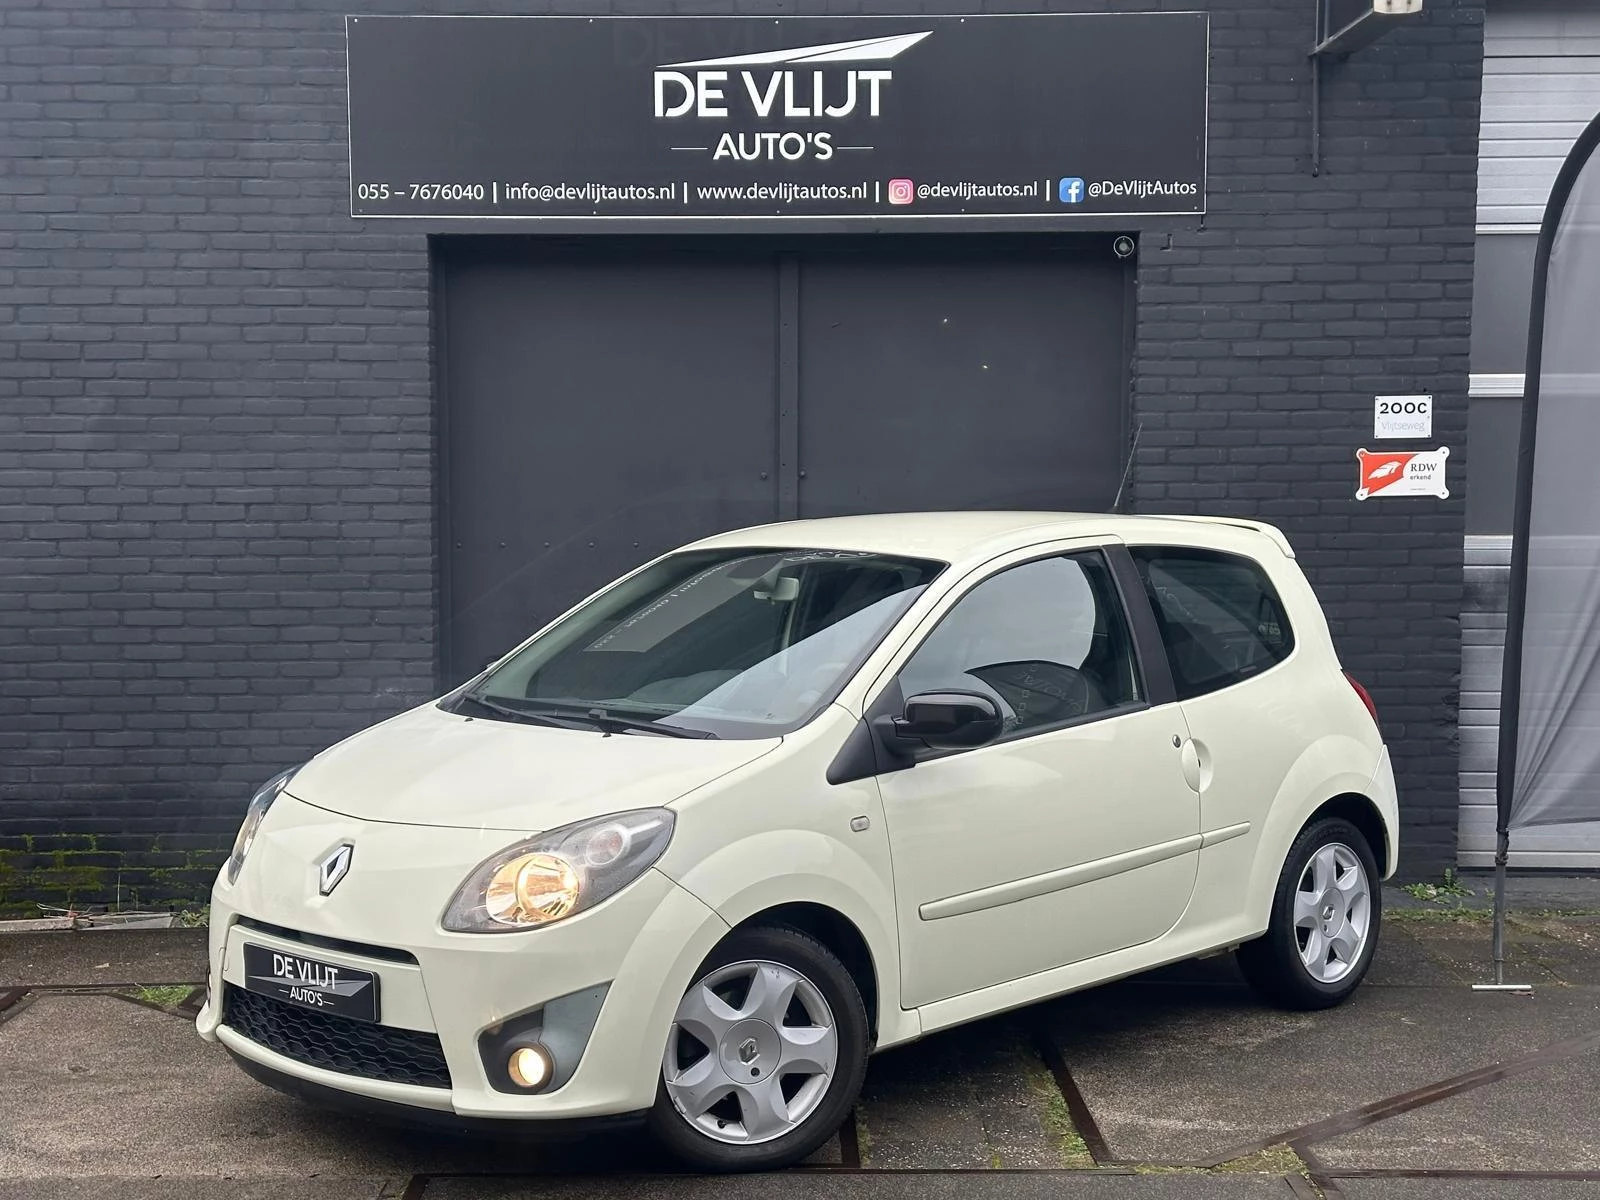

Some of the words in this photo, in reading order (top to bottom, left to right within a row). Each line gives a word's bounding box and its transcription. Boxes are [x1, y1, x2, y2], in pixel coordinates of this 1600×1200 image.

[653, 70, 728, 118] DE
[740, 70, 893, 118] VLIJT
[712, 131, 833, 161] AUTO'S
[357, 183, 390, 200] 055
[409, 183, 485, 201] 7676040
[505, 181, 675, 204] info@devlijtautos.nl
[696, 181, 867, 204] www.devlijtautos.nl
[917, 180, 1038, 203] @devlijtautos.nl
[1088, 179, 1197, 201] @DeVlijtAutos
[1379, 402, 1428, 415] 200C
[1410, 463, 1438, 472] RDW
[273, 953, 294, 979] DE
[295, 959, 339, 990] VLIJT
[289, 986, 323, 1007] AUTO'S
